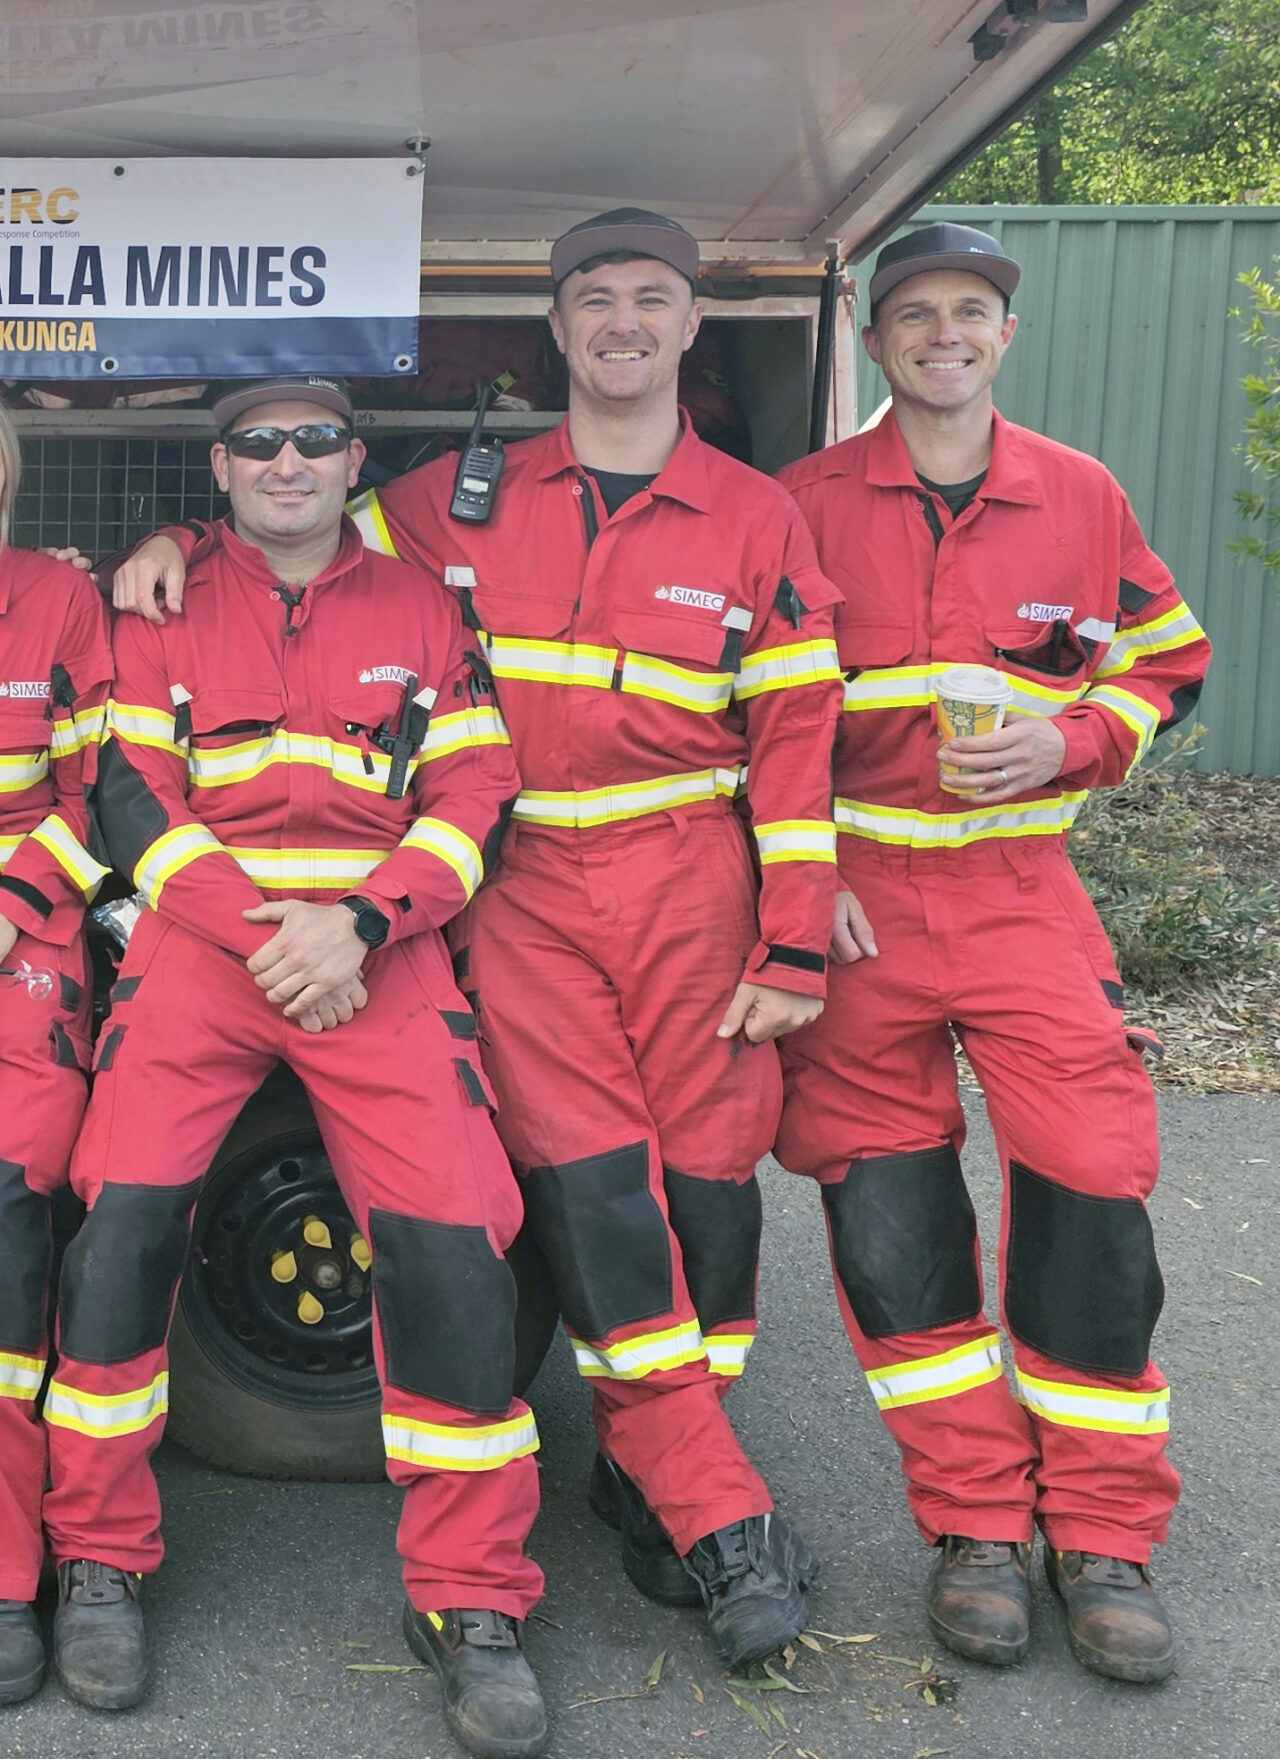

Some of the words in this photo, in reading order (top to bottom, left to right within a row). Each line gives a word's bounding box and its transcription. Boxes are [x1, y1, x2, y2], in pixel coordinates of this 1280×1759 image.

[32, 229, 80, 239] Competition
[125, 245, 326, 307] MINES
[674, 589, 723, 609] SIMEC
[1032, 606, 1072, 621] SIMEC
[376, 667, 409, 683] SIME
[12, 683, 50, 696] SIMEC
